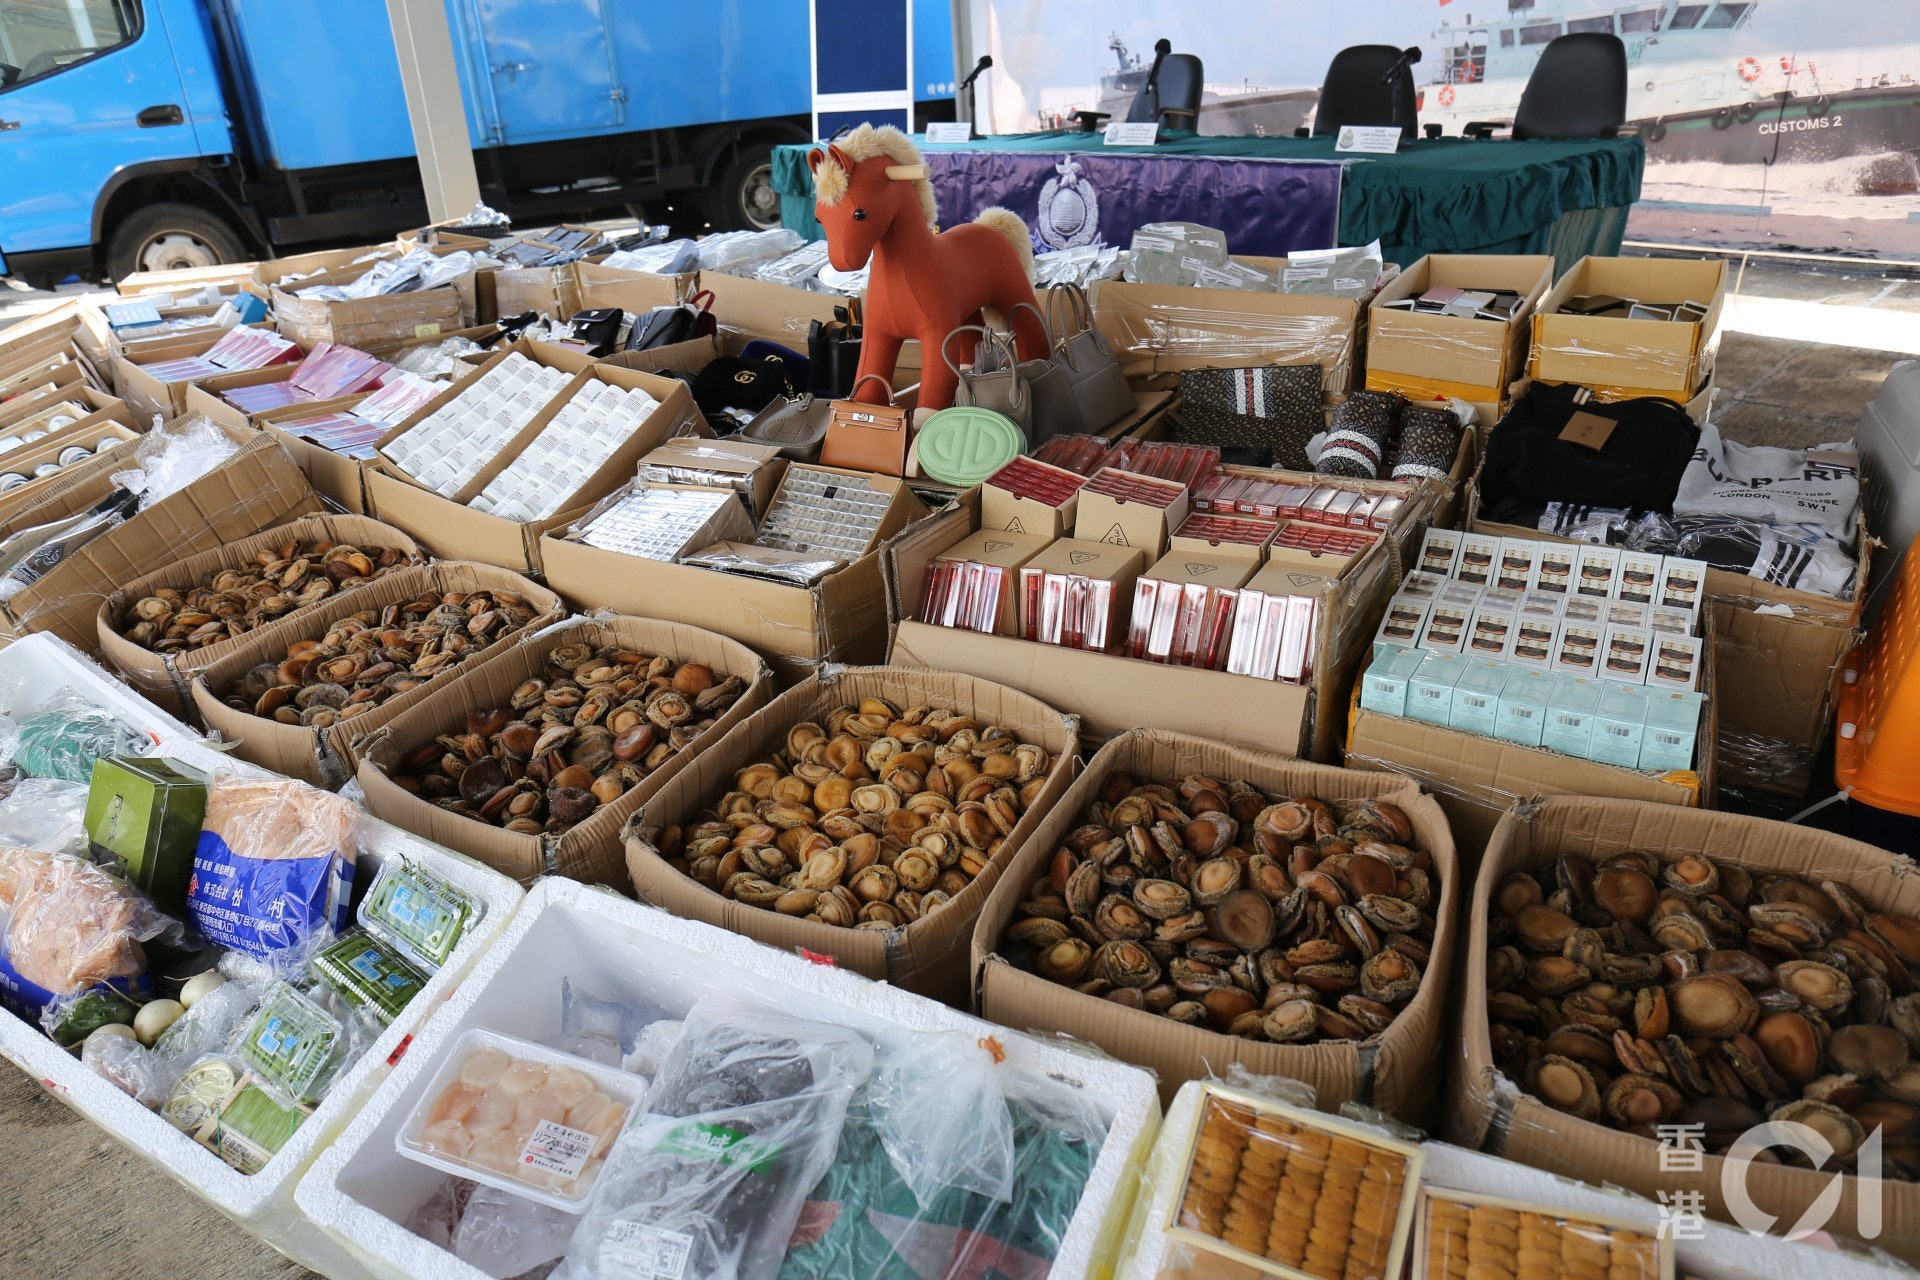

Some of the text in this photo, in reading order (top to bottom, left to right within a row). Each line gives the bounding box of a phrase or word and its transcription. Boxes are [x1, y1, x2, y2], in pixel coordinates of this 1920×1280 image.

[1759, 115, 1842, 134] CUSTOMS 2
[204, 883, 286, 919] 株式会社 松 村
